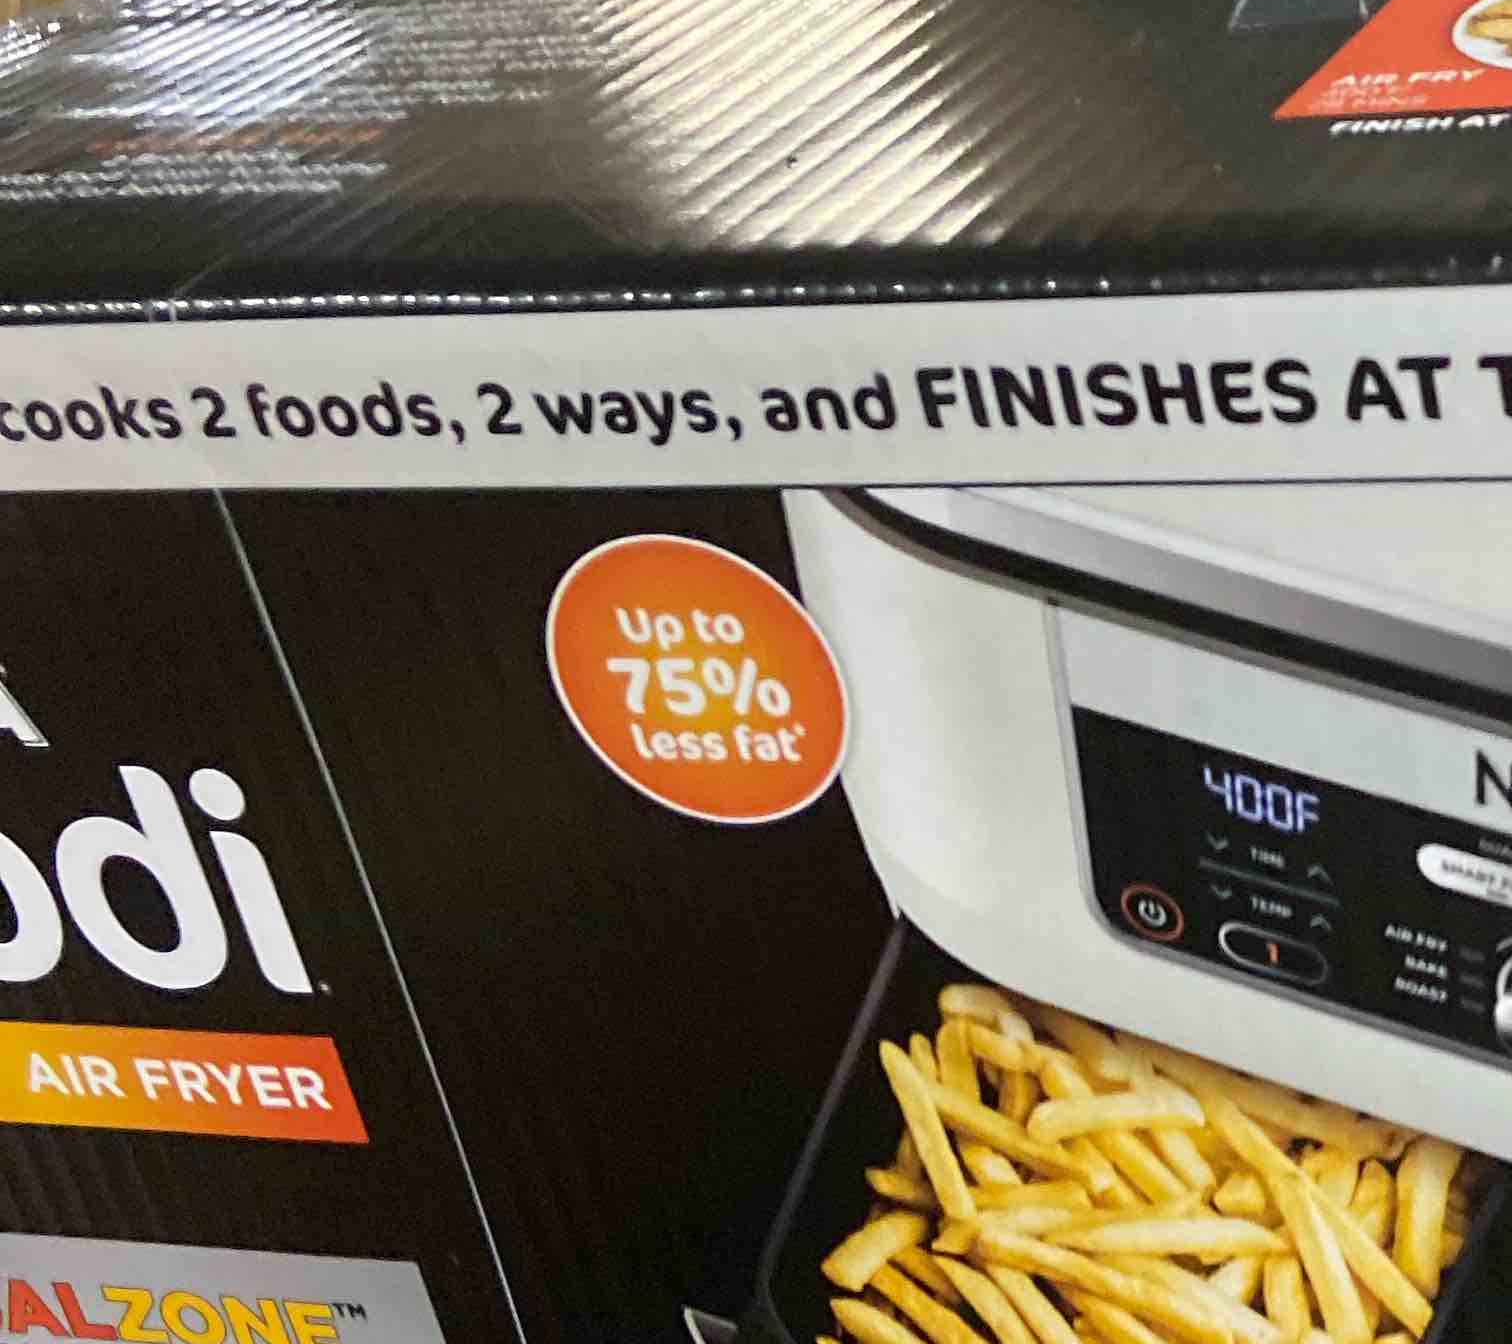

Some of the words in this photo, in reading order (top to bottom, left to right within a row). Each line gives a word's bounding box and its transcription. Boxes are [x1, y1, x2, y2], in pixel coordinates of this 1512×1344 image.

[1331, 72, 1399, 87] AIR
[1407, 68, 1485, 83] FRY
[1329, 115, 1454, 138] FINISH
[1458, 112, 1512, 131] AT
[0, 385, 182, 443] cooks
[191, 386, 236, 440] 2
[247, 380, 467, 445] foods,
[477, 382, 523, 436] 2
[534, 387, 744, 447] ways,
[761, 373, 897, 432] and
[915, 359, 1319, 429] FINISHES
[1345, 355, 1452, 423] AT
[614, 606, 686, 651] Up
[690, 608, 745, 645] to
[605, 656, 792, 718] 75%
[629, 722, 730, 761] less
[1202, 763, 1322, 833] 400F
[27, 1051, 128, 1099] AIR
[133, 1058, 334, 1111] FRYER
